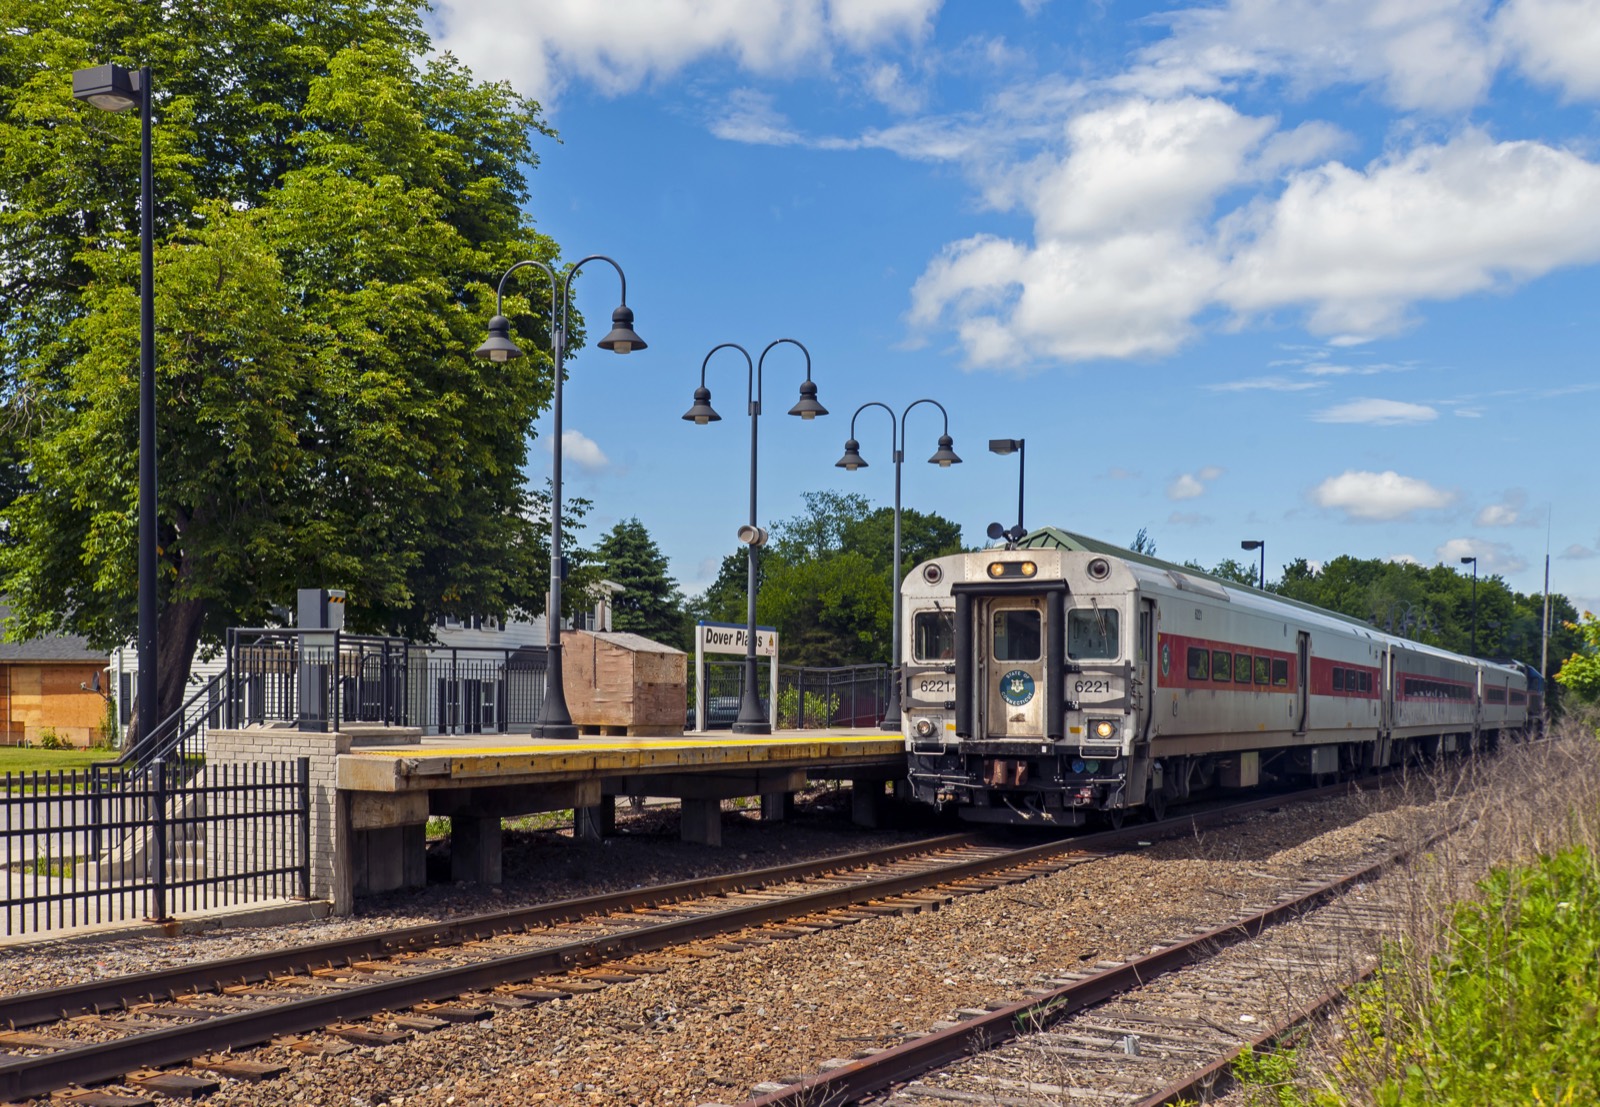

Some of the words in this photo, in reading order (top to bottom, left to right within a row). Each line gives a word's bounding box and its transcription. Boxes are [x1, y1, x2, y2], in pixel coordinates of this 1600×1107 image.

[706, 628, 733, 645] Dover
[736, 631, 762, 647] Plas
[1006, 671, 1021, 679] STATE
[920, 680, 950, 693] 6221
[1075, 680, 1109, 693] 6221
[1002, 692, 1032, 705] CONNECTICUT
